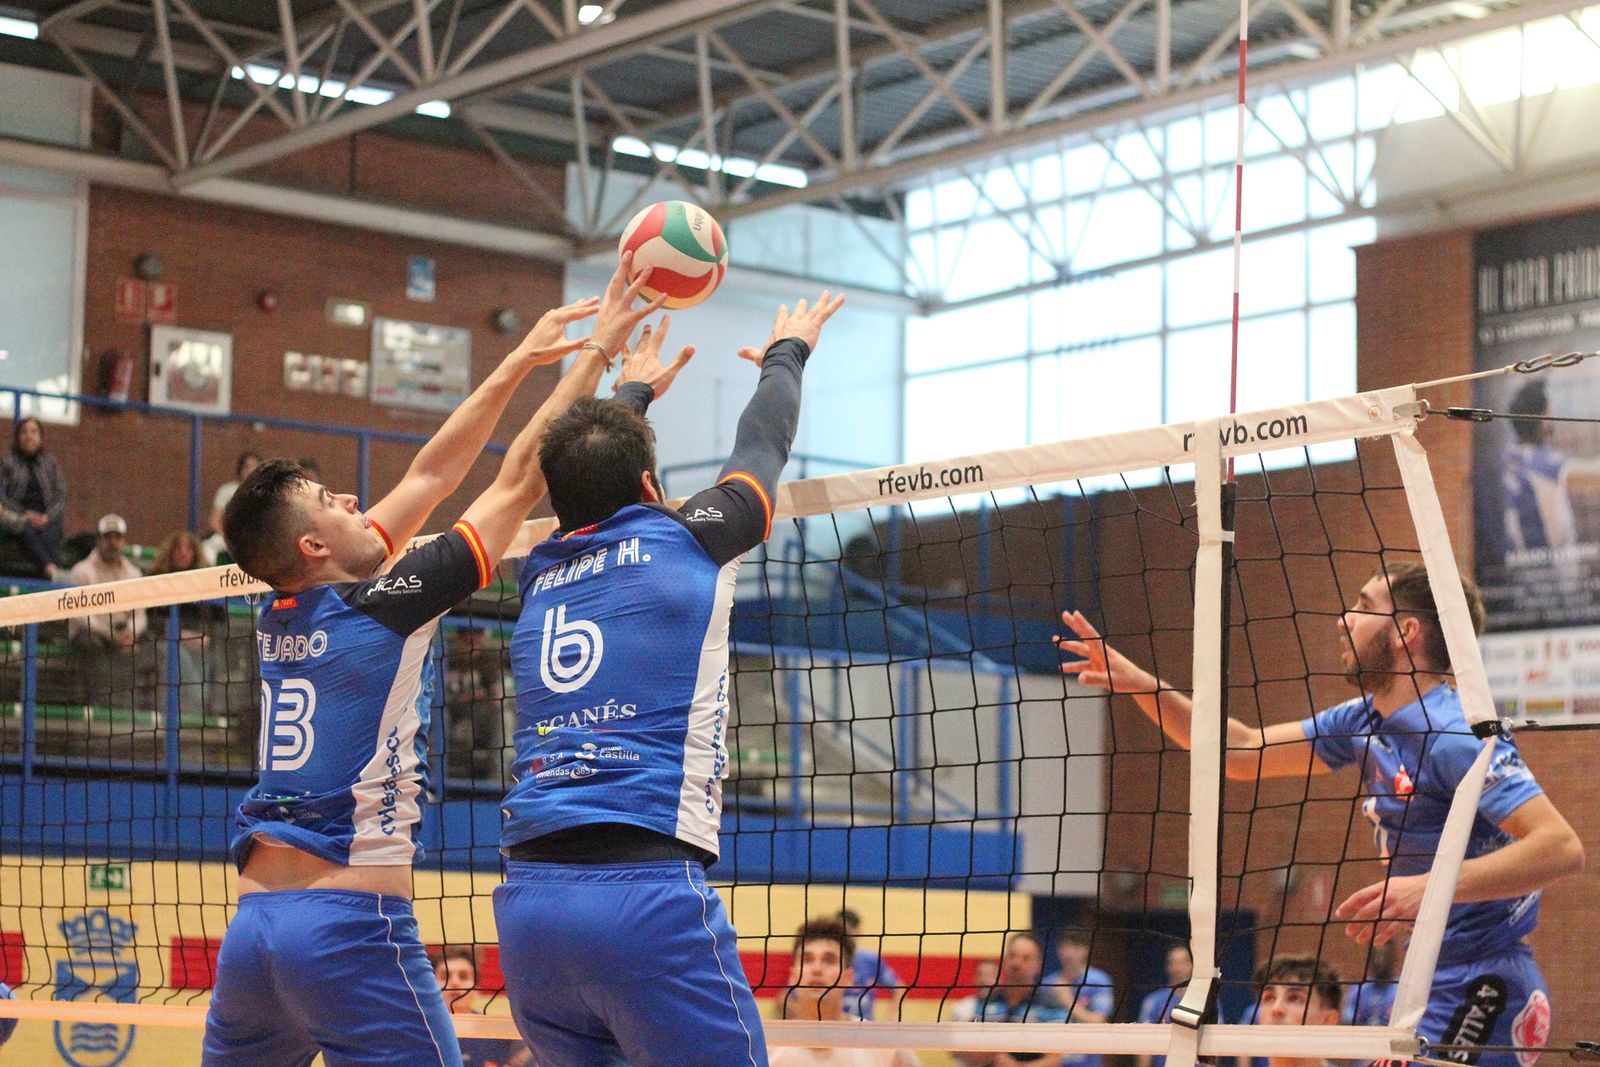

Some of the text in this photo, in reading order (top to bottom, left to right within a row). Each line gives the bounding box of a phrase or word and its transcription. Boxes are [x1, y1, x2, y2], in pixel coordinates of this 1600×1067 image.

[1183, 414, 1308, 452] rvb.com
[878, 464, 984, 496] rfevb.com
[532, 537, 651, 597] FELIPE H.
[57, 589, 116, 612] rfevb.com
